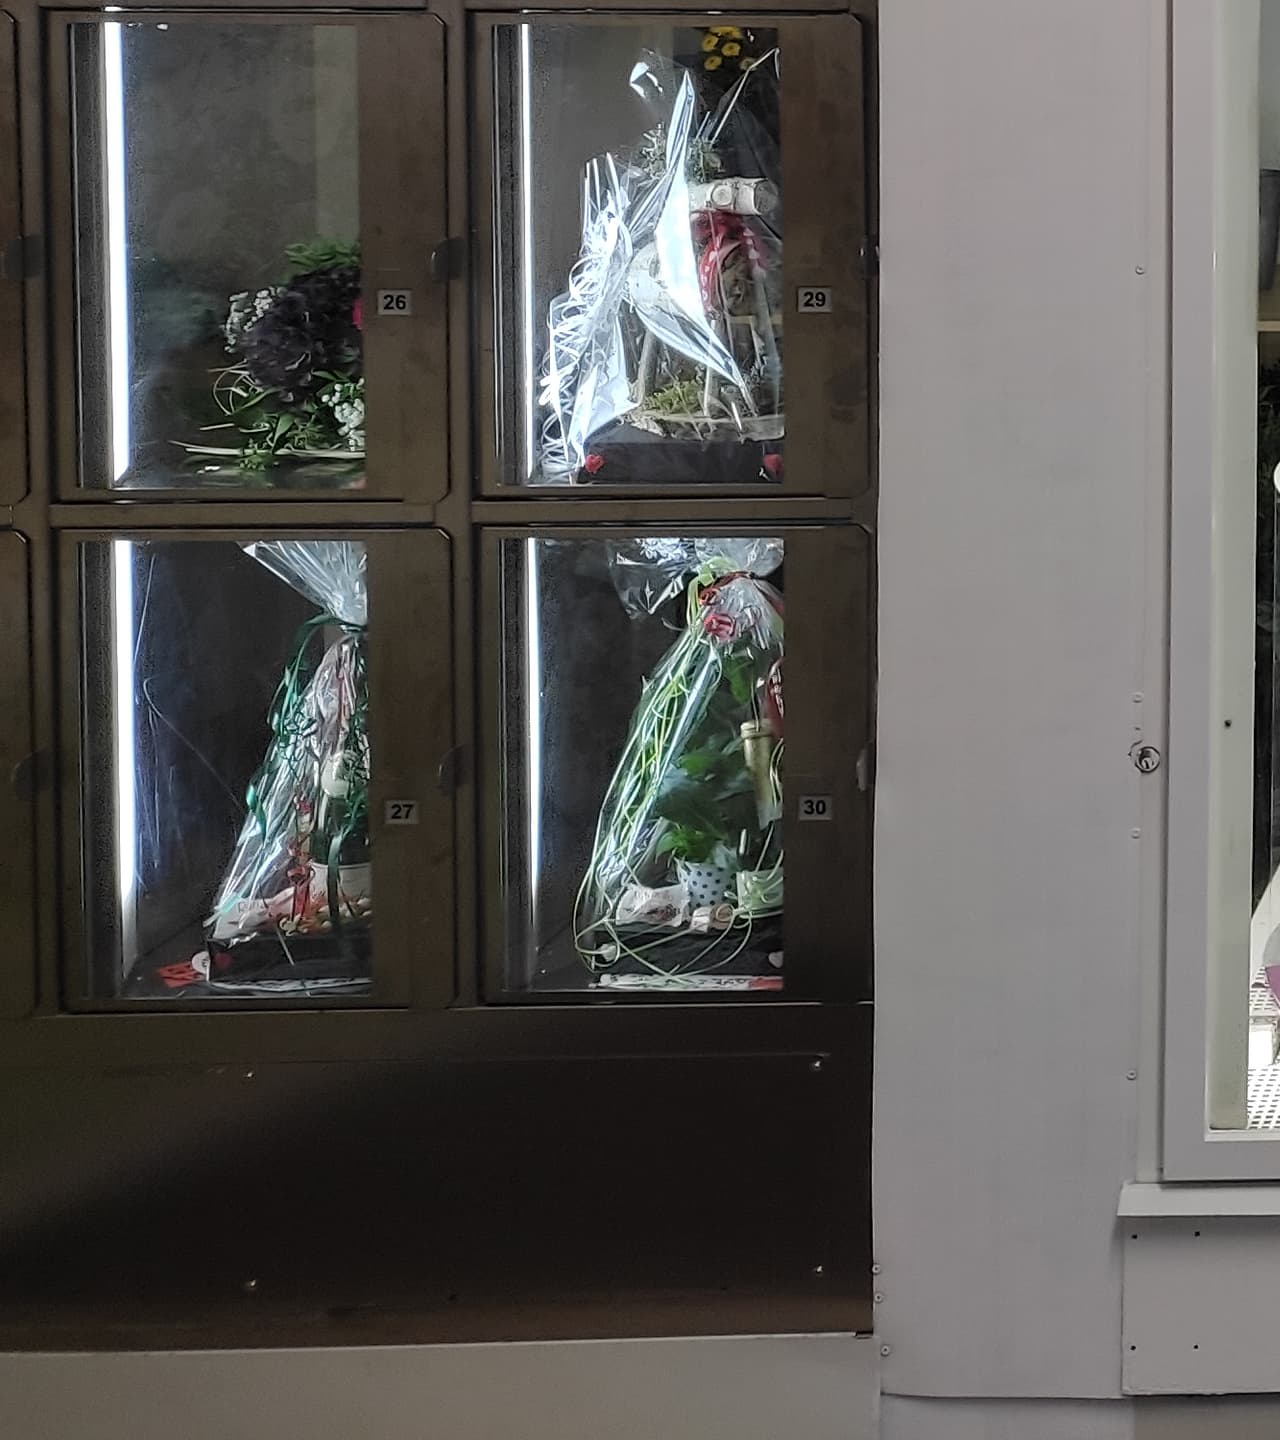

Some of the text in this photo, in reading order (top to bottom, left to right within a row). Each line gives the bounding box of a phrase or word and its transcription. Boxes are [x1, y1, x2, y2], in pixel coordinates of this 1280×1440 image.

[384, 295, 406, 310] 26
[804, 292, 825, 308] 29
[391, 803, 414, 820] 27
[804, 799, 826, 815] 30
